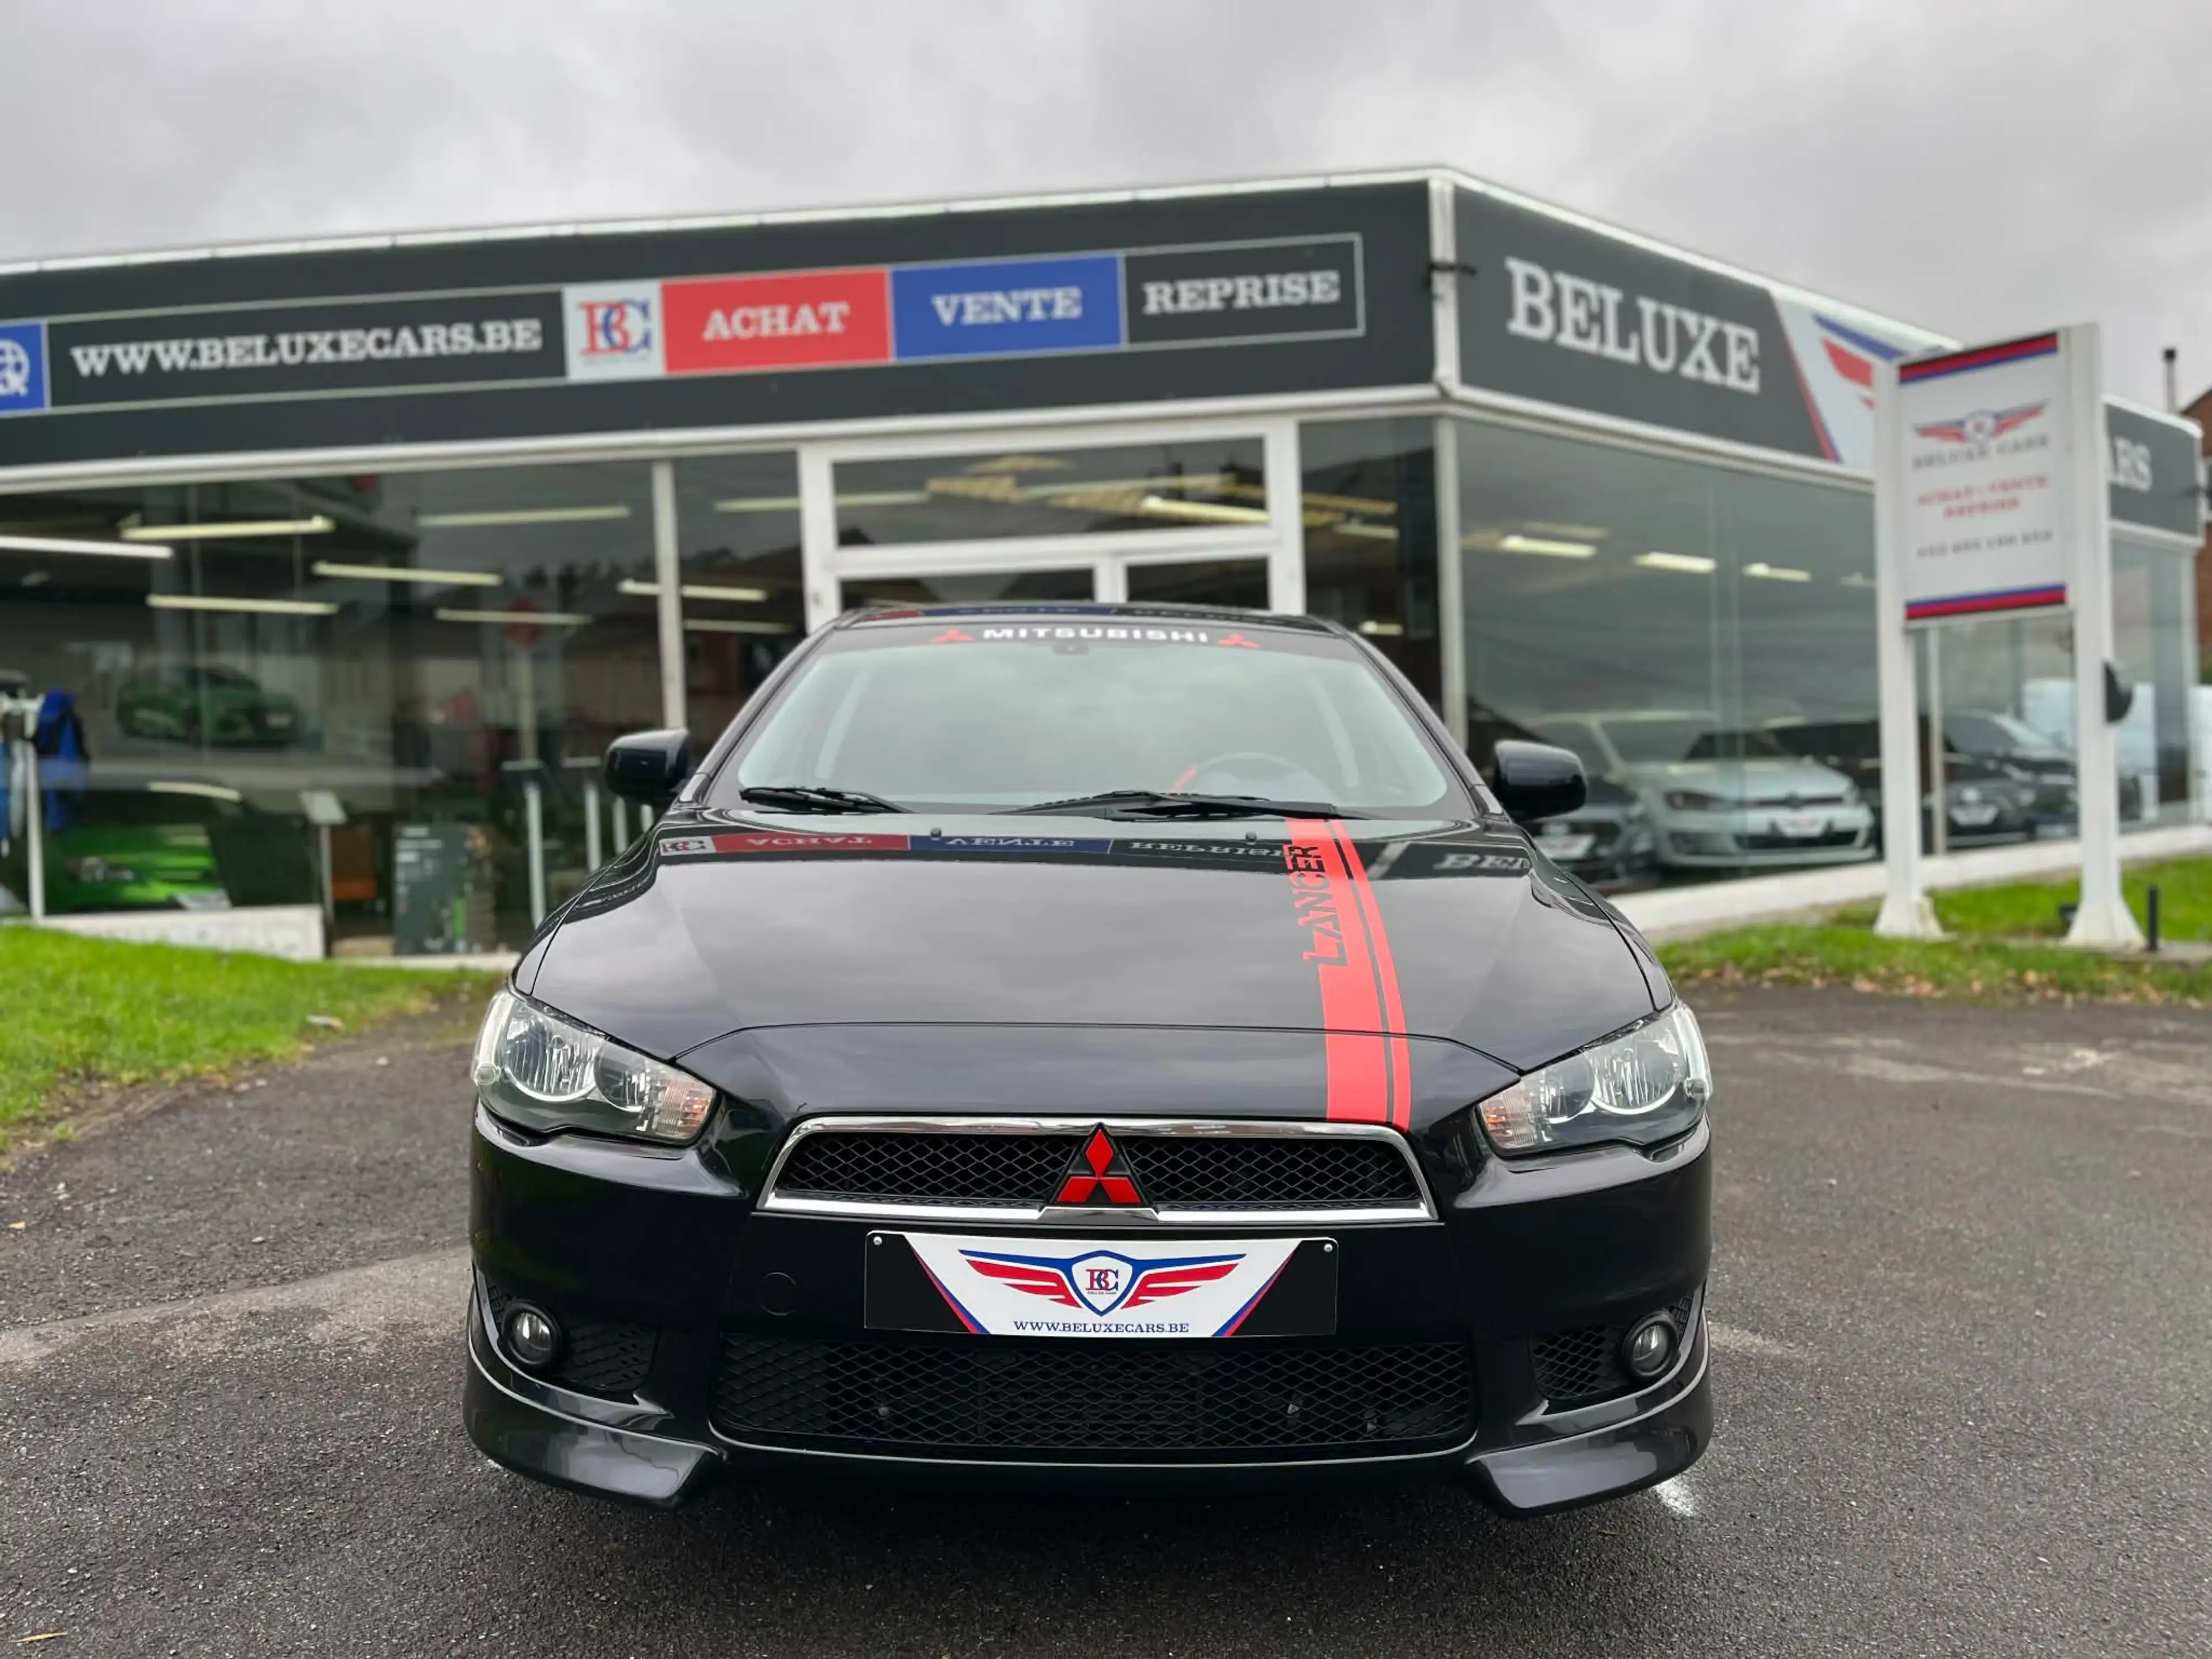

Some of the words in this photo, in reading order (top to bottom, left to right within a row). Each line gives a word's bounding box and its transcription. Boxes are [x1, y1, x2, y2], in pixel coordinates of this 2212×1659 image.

[931, 287, 1084, 326] VENTE
[1143, 270, 1340, 316] REPRISE
[702, 302, 850, 342] ACHAT
[1504, 256, 1760, 395] BELUXE
[71, 319, 542, 377] WWW.BELUXECARS.BE
[983, 628, 1209, 642] MITSUBISHI
[1285, 843, 1349, 967] LANCER
[1013, 1321, 1190, 1333] WWW.BELUXECARS.BE
